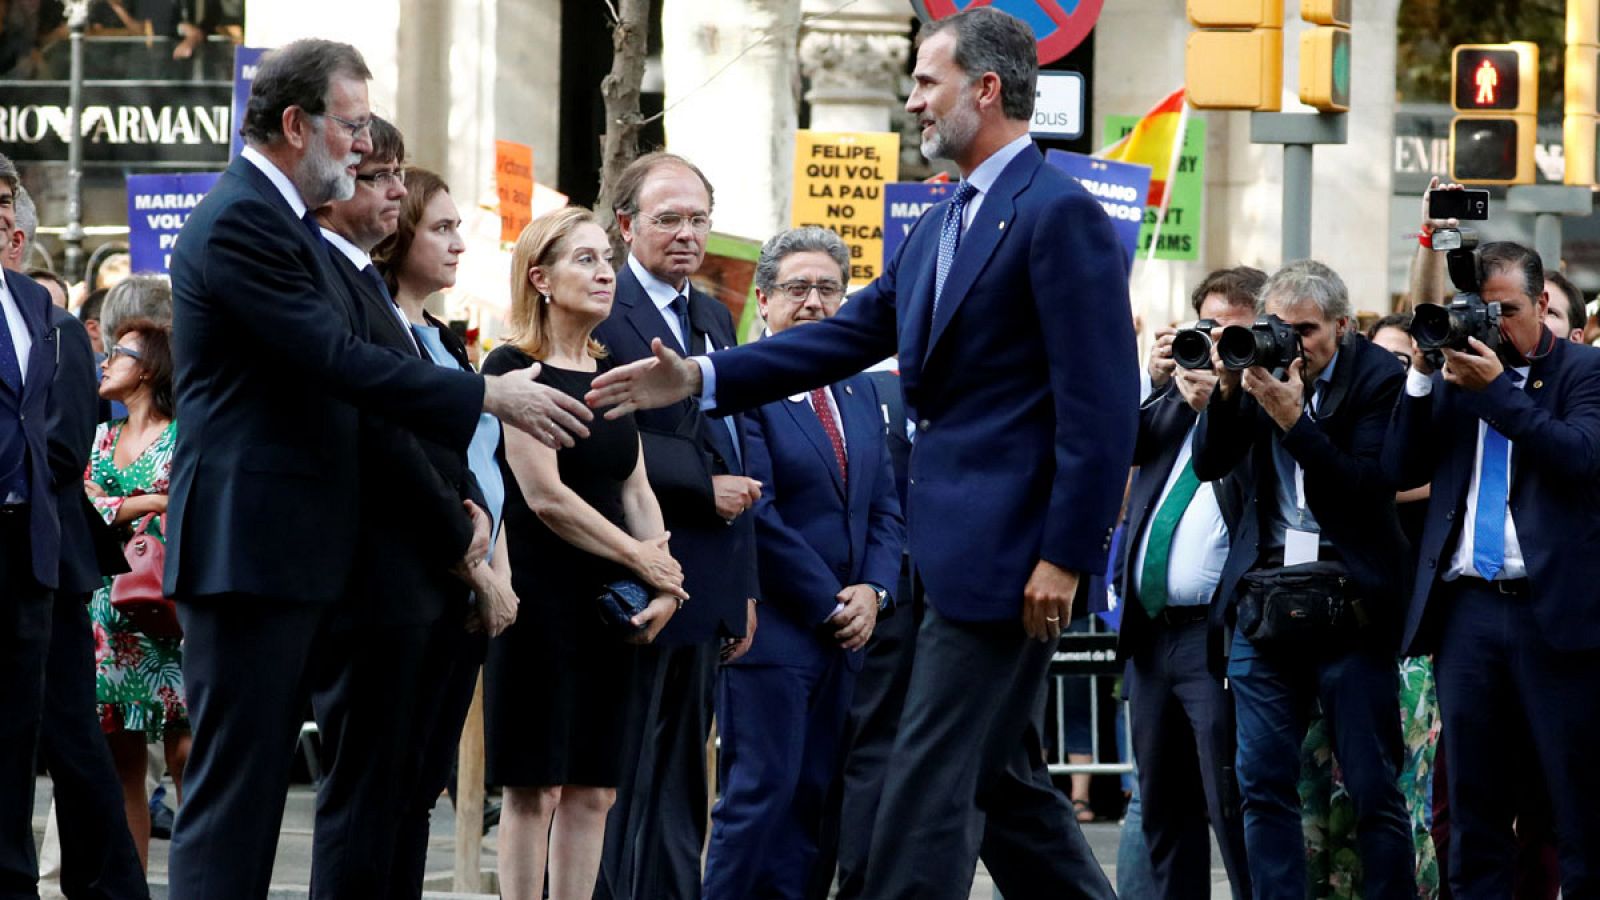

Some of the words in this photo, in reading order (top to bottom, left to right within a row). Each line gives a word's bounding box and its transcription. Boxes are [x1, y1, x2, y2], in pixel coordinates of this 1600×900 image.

[92, 106, 229, 143] ARMANI
[1035, 107, 1068, 126] bus
[811, 144, 881, 162] FELIPE,
[806, 164, 840, 179] QUI
[845, 165, 884, 180] VOL
[808, 184, 833, 198] LA
[839, 184, 879, 200] PAU
[1075, 177, 1137, 202] RIANO
[826, 203, 855, 219] NO
[1098, 199, 1141, 222] MOS
[146, 213, 191, 229] VOL
[800, 223, 884, 240] AFICA
